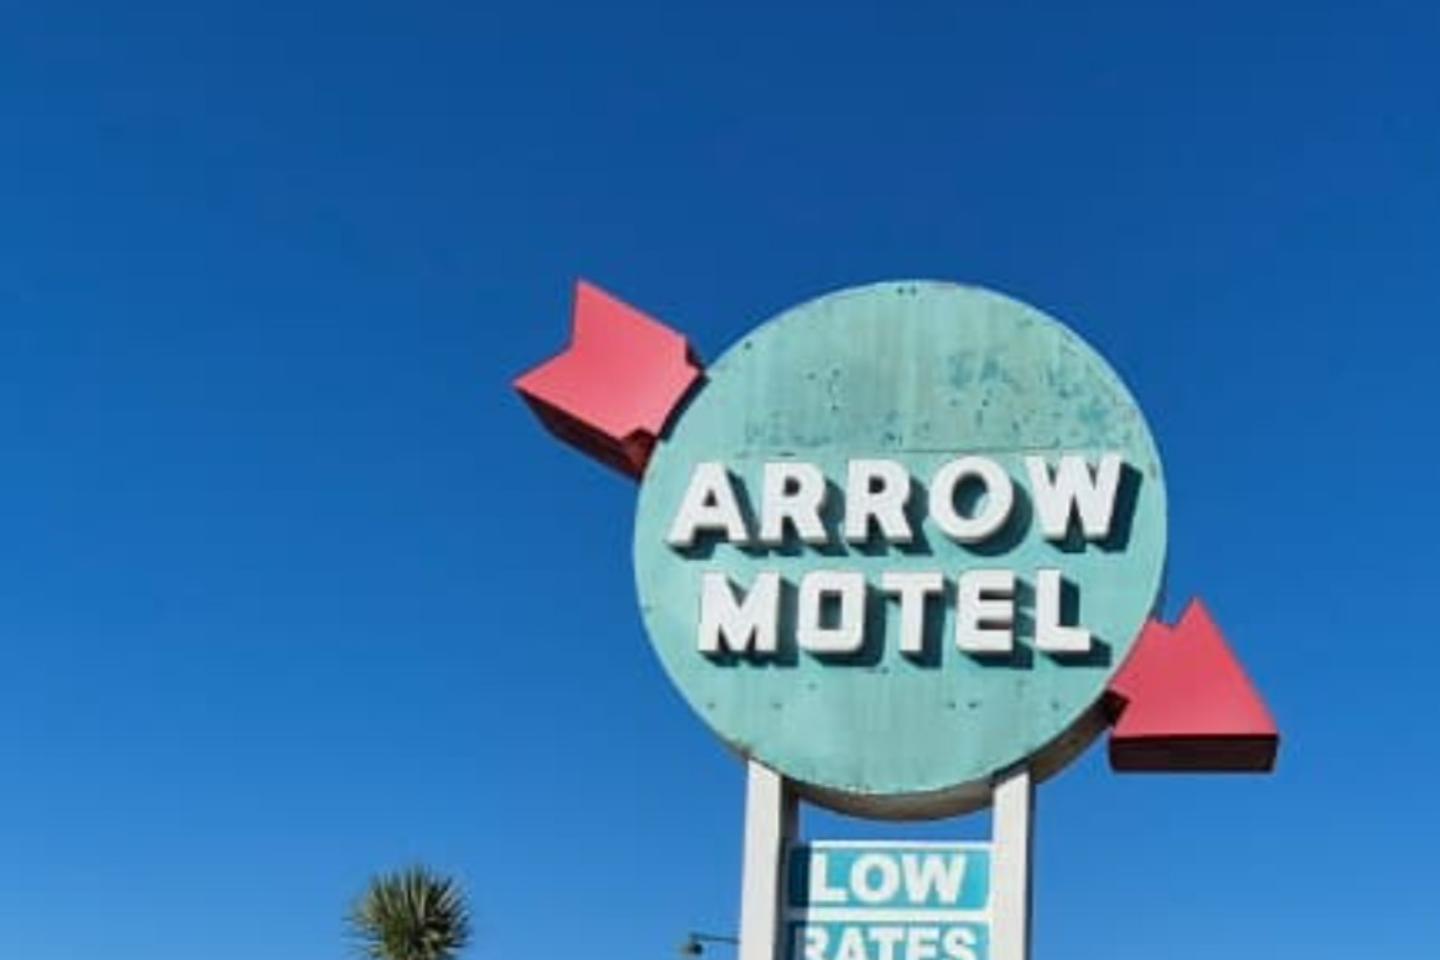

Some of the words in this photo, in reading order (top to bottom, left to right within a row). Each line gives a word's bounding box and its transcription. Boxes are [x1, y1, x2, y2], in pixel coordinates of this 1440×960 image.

[666, 454, 1128, 552] ARROW
[696, 567, 1098, 660] MOTEL
[808, 851, 967, 904] LOW
